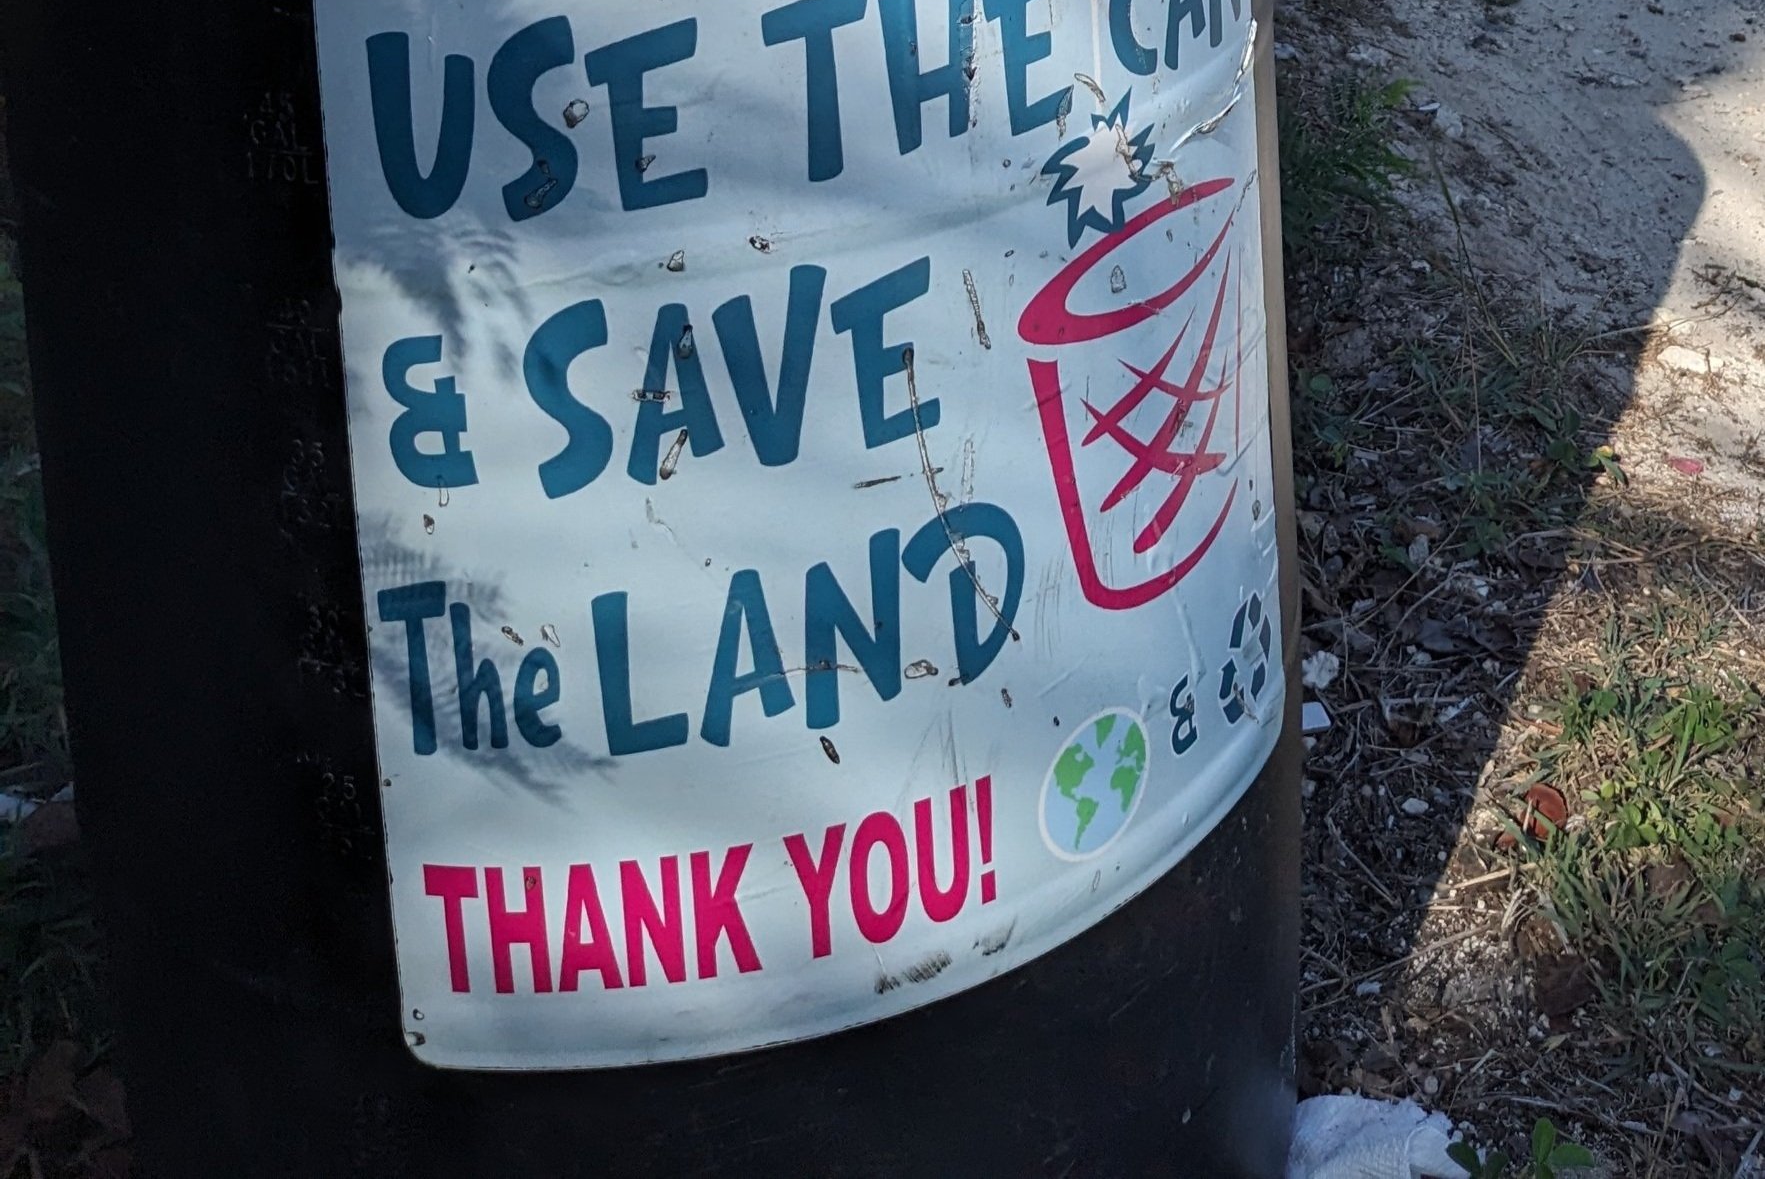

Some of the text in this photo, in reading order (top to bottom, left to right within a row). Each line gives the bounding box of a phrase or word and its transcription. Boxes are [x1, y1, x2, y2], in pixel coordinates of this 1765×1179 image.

[366, 16, 709, 221] USE
[382, 257, 941, 499] & SAVE
[378, 503, 1026, 756] The LAND
[423, 774, 997, 994] THANK YOU!
